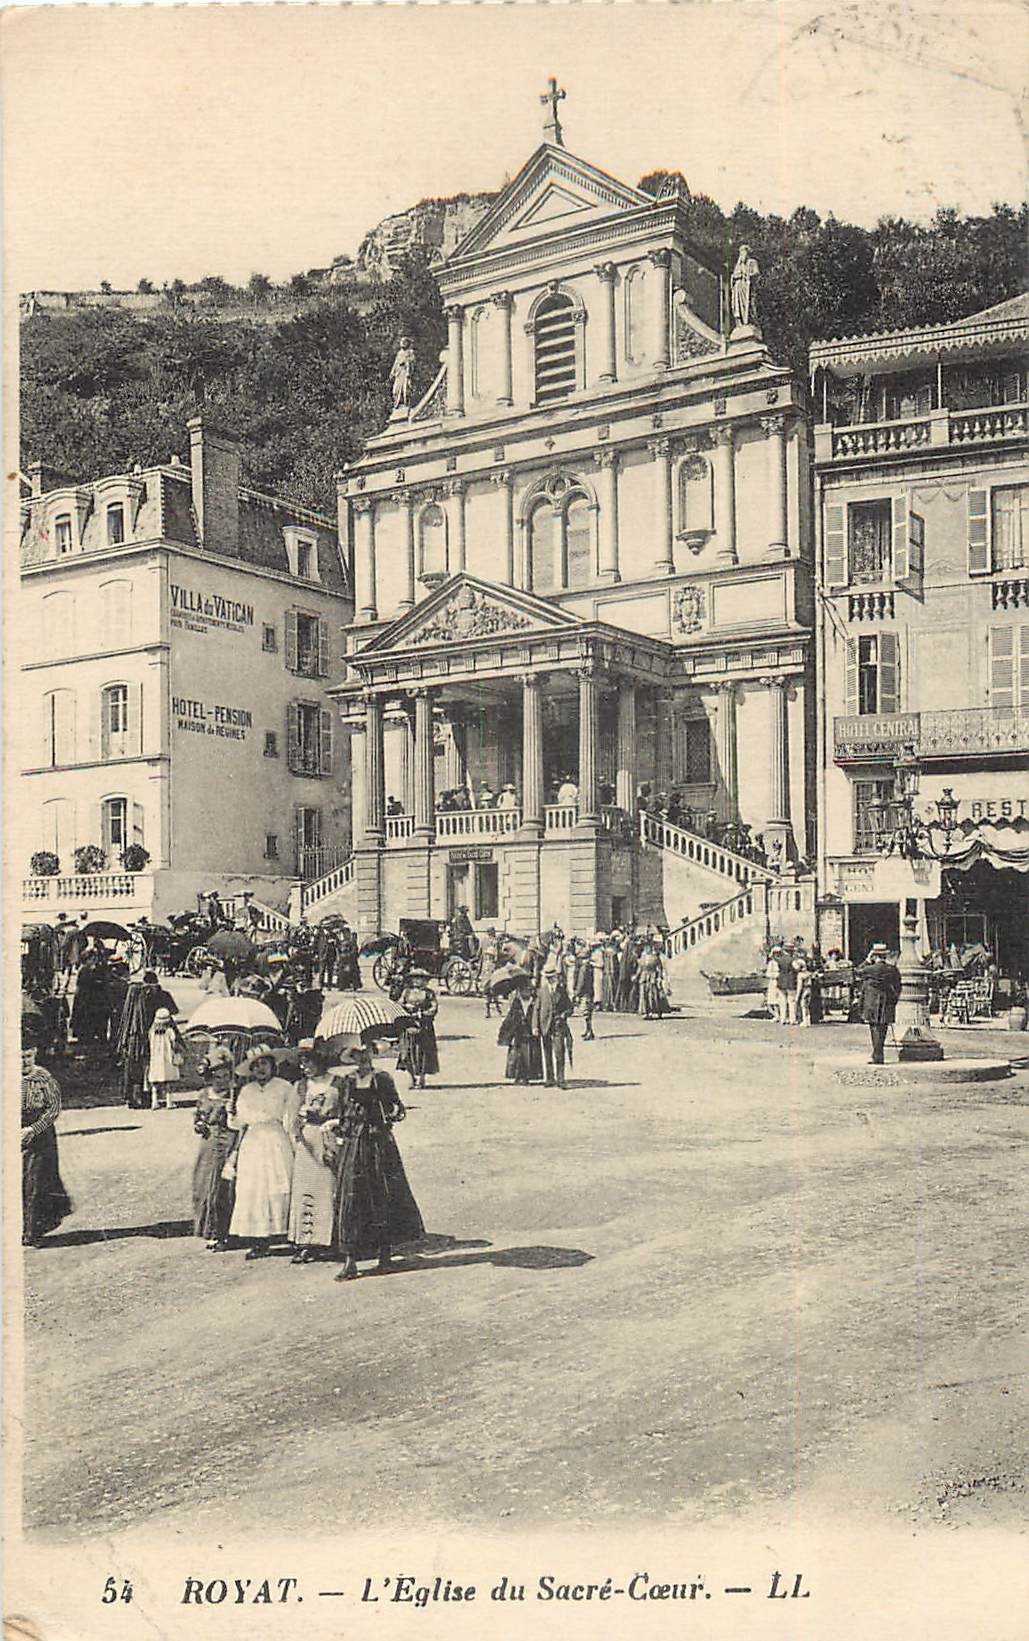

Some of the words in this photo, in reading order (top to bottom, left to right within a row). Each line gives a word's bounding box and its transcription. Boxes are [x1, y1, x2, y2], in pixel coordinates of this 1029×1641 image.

[170, 585, 202, 613] VILLA
[212, 595, 254, 625] VATICAN
[177, 719, 206, 734] MAISON
[873, 718, 919, 737] CENTRAL
